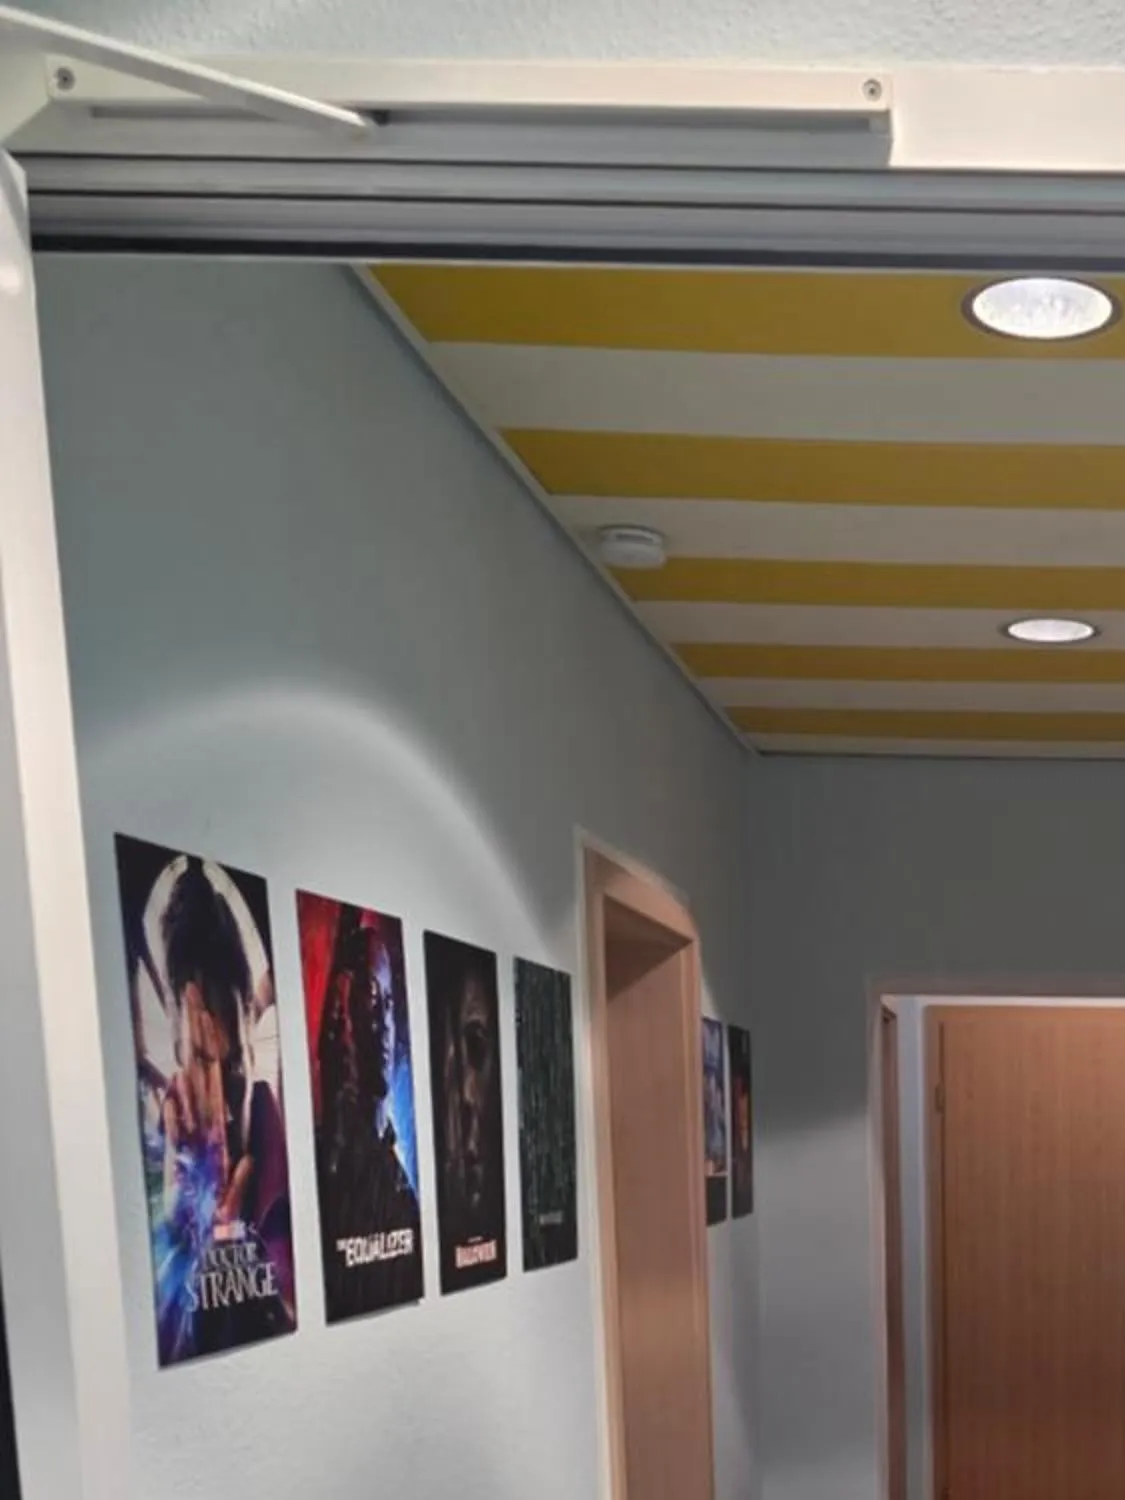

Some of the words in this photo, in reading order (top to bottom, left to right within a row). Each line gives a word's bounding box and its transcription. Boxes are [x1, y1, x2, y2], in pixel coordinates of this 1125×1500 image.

[201, 1241, 258, 1272] DOCTOR
[345, 1227, 414, 1268] EQUALIZER
[184, 1260, 279, 1312] STRANGE
